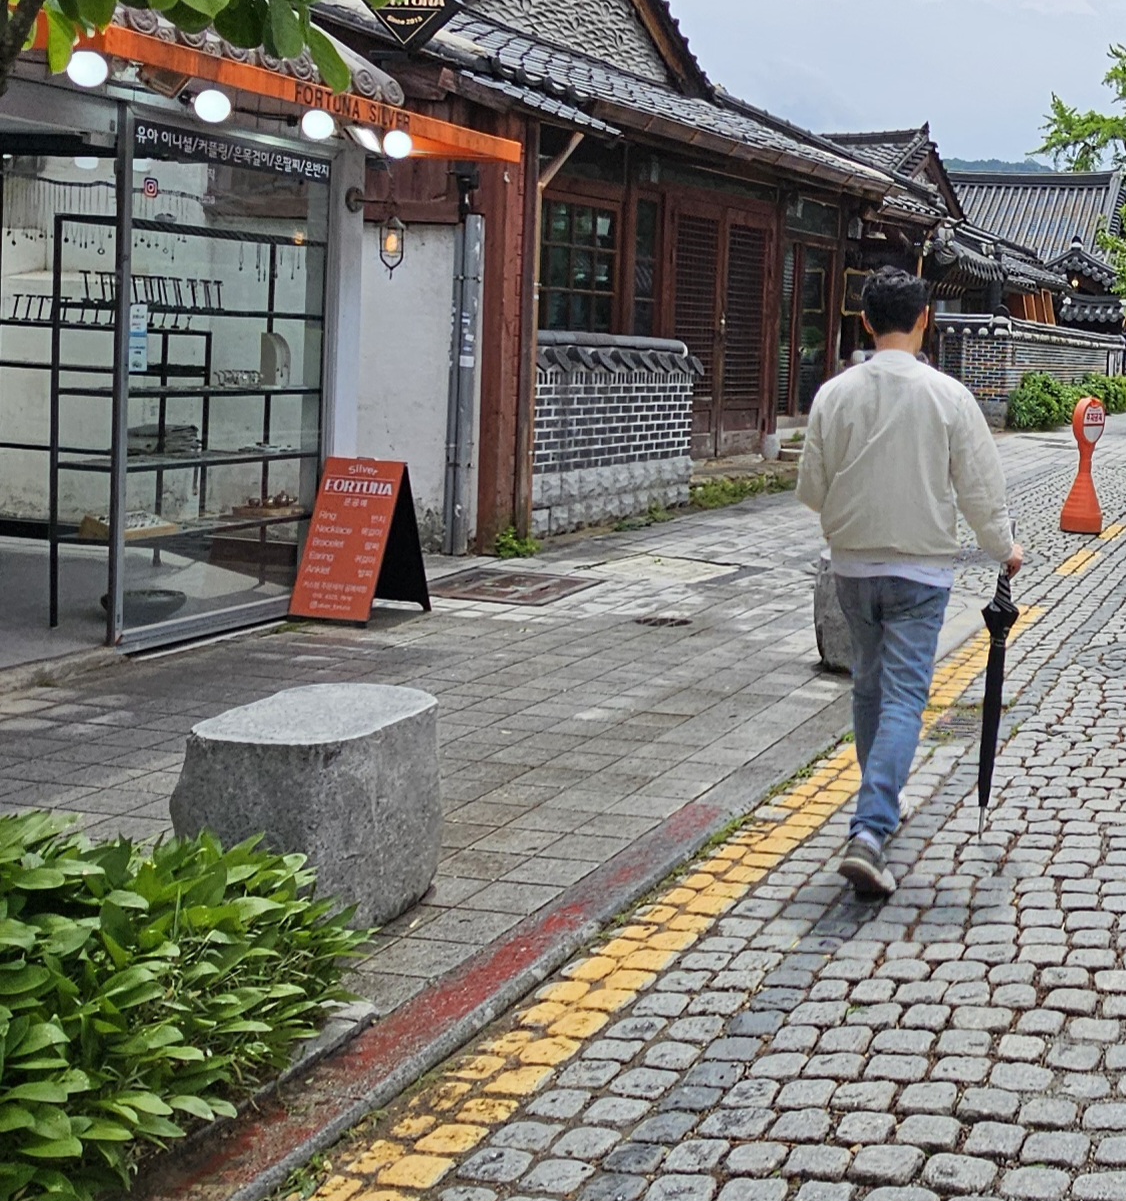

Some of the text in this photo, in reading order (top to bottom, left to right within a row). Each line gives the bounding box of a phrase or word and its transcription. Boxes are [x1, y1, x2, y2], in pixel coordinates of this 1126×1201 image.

[295, 84, 410, 132] FORTUNA SILVER
[136, 125, 158, 145] 유아
[348, 464, 379, 476] Silver
[325, 479, 393, 496] FORTUNA
[319, 511, 337, 521] Ring
[316, 525, 352, 535] Necklace
